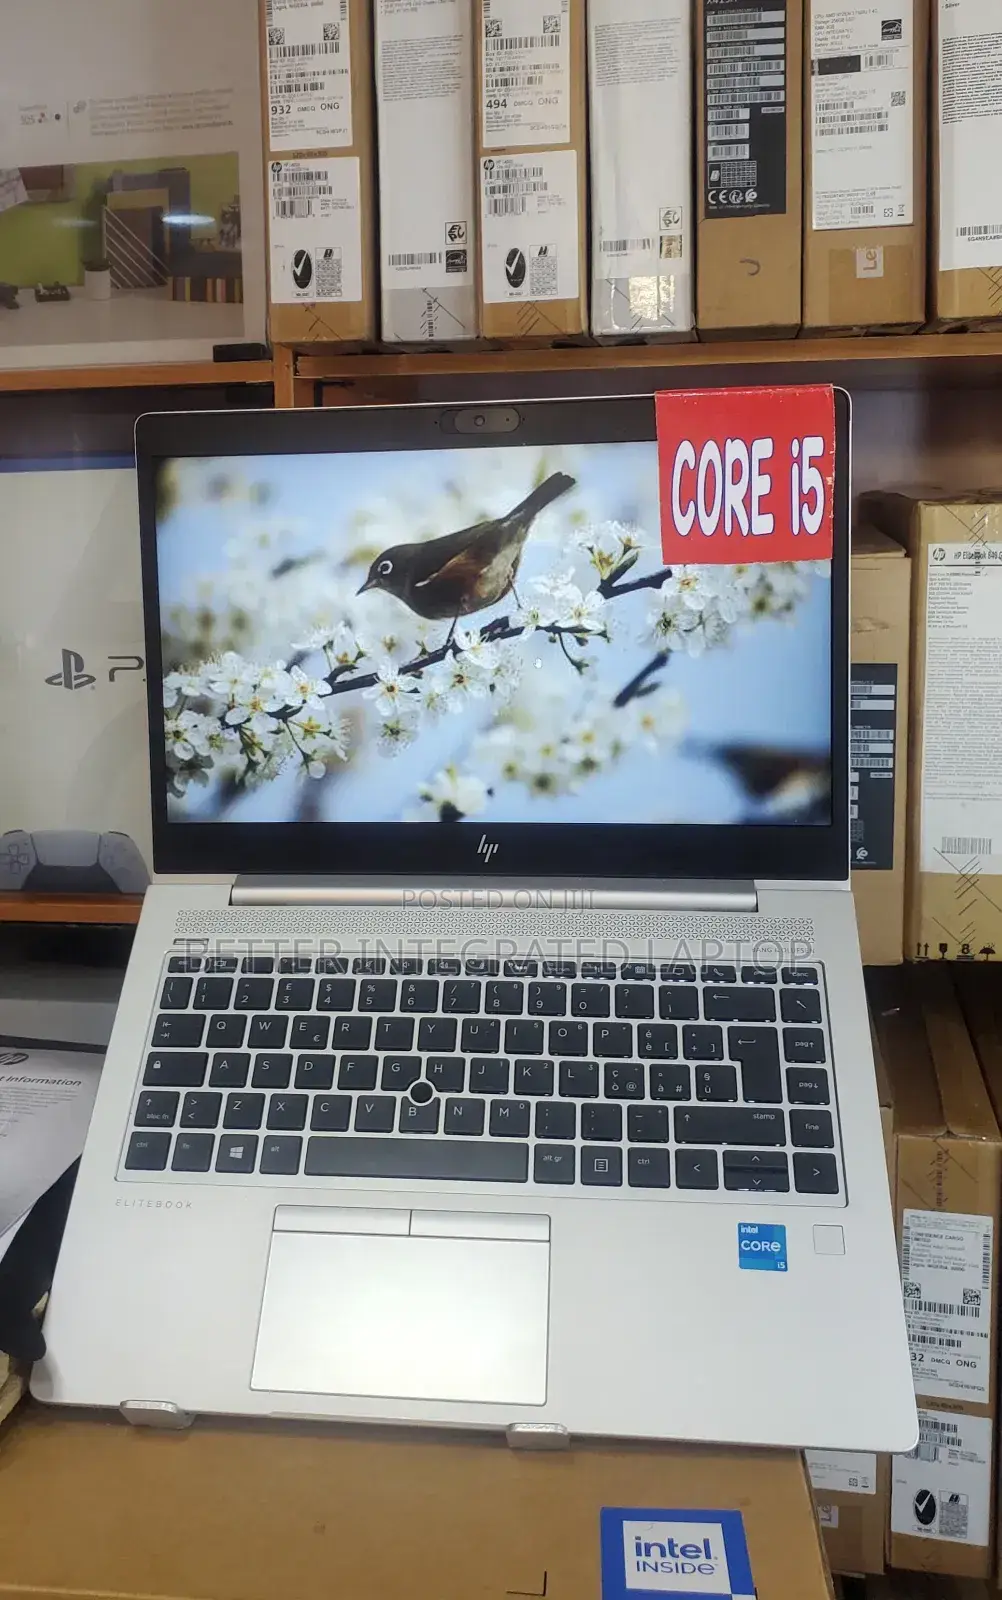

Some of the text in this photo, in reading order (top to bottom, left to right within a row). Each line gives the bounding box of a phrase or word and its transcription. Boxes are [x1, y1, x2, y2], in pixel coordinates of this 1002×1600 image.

[271, 104, 292, 115] 932
[320, 101, 340, 111] ONG
[486, 98, 508, 109] 494
[537, 97, 559, 106] ONG
[671, 435, 826, 537] CORE i5
[476, 834, 499, 863] hp
[325, 983, 332, 992] $
[366, 984, 376, 993] %
[408, 984, 416, 993] &
[200, 994, 206, 1003] 1
[241, 995, 249, 1003] 2
[282, 995, 290, 1004] 3
[324, 996, 331, 1004] 4
[365, 996, 373, 1005] 5
[407, 997, 415, 1006] 6
[450, 998, 457, 1006] 7
[492, 999, 500, 1007] 8
[535, 1000, 544, 1009] 9
[216, 1021, 227, 1031] Q
[258, 1021, 272, 1031] W
[298, 1022, 308, 1031] E
[312, 1034, 321, 1043] €
[341, 1023, 350, 1032] R
[383, 1023, 392, 1033] T
[427, 1024, 436, 1034] Y
[470, 1025, 479, 1035] U
[557, 1028, 568, 1037] O
[601, 1029, 610, 1039] P
[219, 1060, 230, 1070] A
[261, 1061, 271, 1071] S
[304, 1061, 314, 1071] D
[346, 1062, 355, 1072] F
[391, 1063, 401, 1072] G
[433, 1064, 443, 1074] H
[477, 1065, 486, 1075] J
[522, 1067, 532, 1077] K
[567, 1068, 575, 1078] L
[6, 1075, 82, 1087] Information
[625, 1081, 637, 1092] @
[675, 1084, 683, 1093] #
[232, 1101, 242, 1110] Z
[276, 1102, 286, 1111] X
[320, 1102, 330, 1112] C
[365, 1103, 375, 1113] V
[408, 1107, 417, 1117] B
[453, 1106, 463, 1116] N
[499, 1107, 510, 1118] M
[752, 1112, 776, 1121] stamp
[805, 1123, 820, 1131] fine
[135, 1141, 149, 1149] ctrl
[270, 1145, 280, 1153] alt
[542, 1154, 553, 1162] alt
[553, 1155, 563, 1163] gr
[637, 1158, 651, 1166] ctrl
[115, 1198, 193, 1209] ELITEBOOK
[740, 1224, 759, 1234] intel
[777, 1261, 786, 1269] i5
[910, 1352, 925, 1363] 32
[955, 1358, 978, 1369] ONG
[634, 1536, 712, 1560] intel
